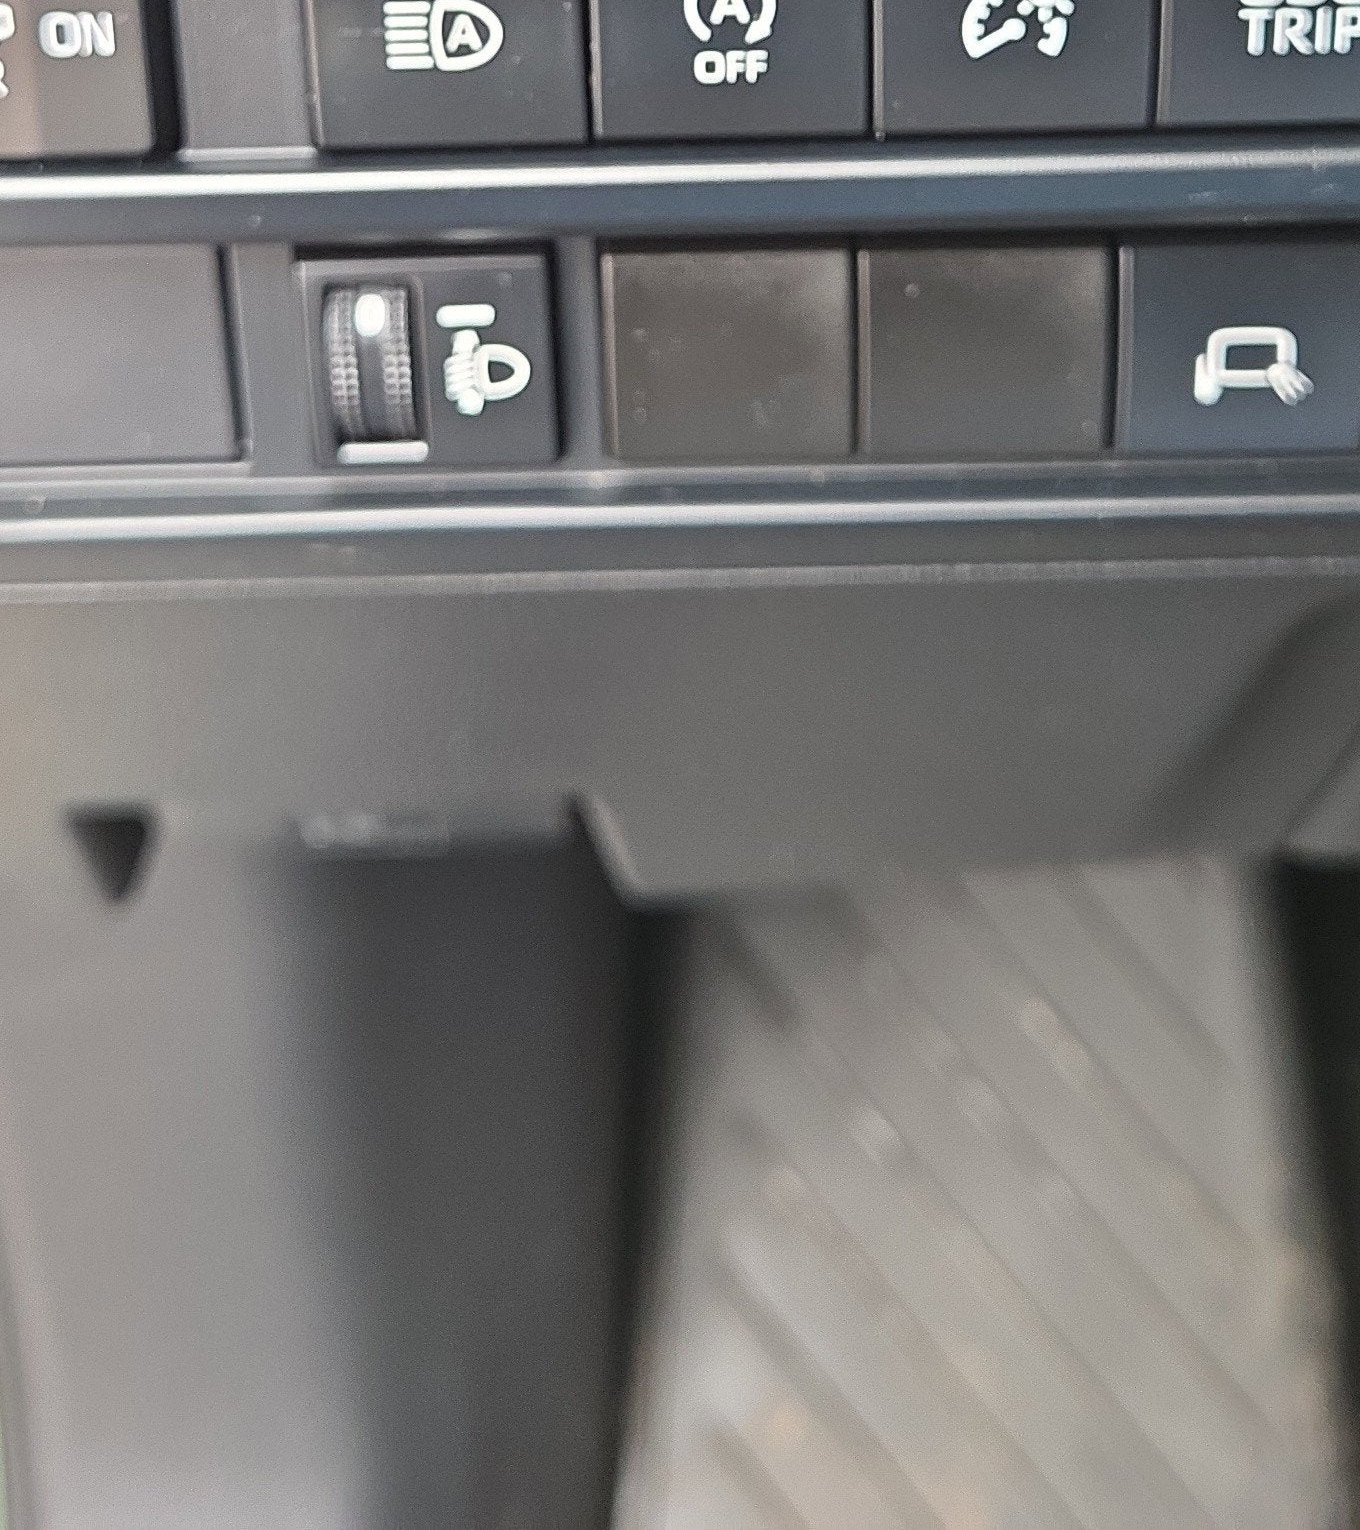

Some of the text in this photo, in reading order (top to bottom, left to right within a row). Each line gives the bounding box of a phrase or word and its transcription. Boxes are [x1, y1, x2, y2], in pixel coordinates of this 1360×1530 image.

[40, 10, 117, 58] ON
[447, 13, 482, 51] A
[693, 50, 768, 84] OFF
